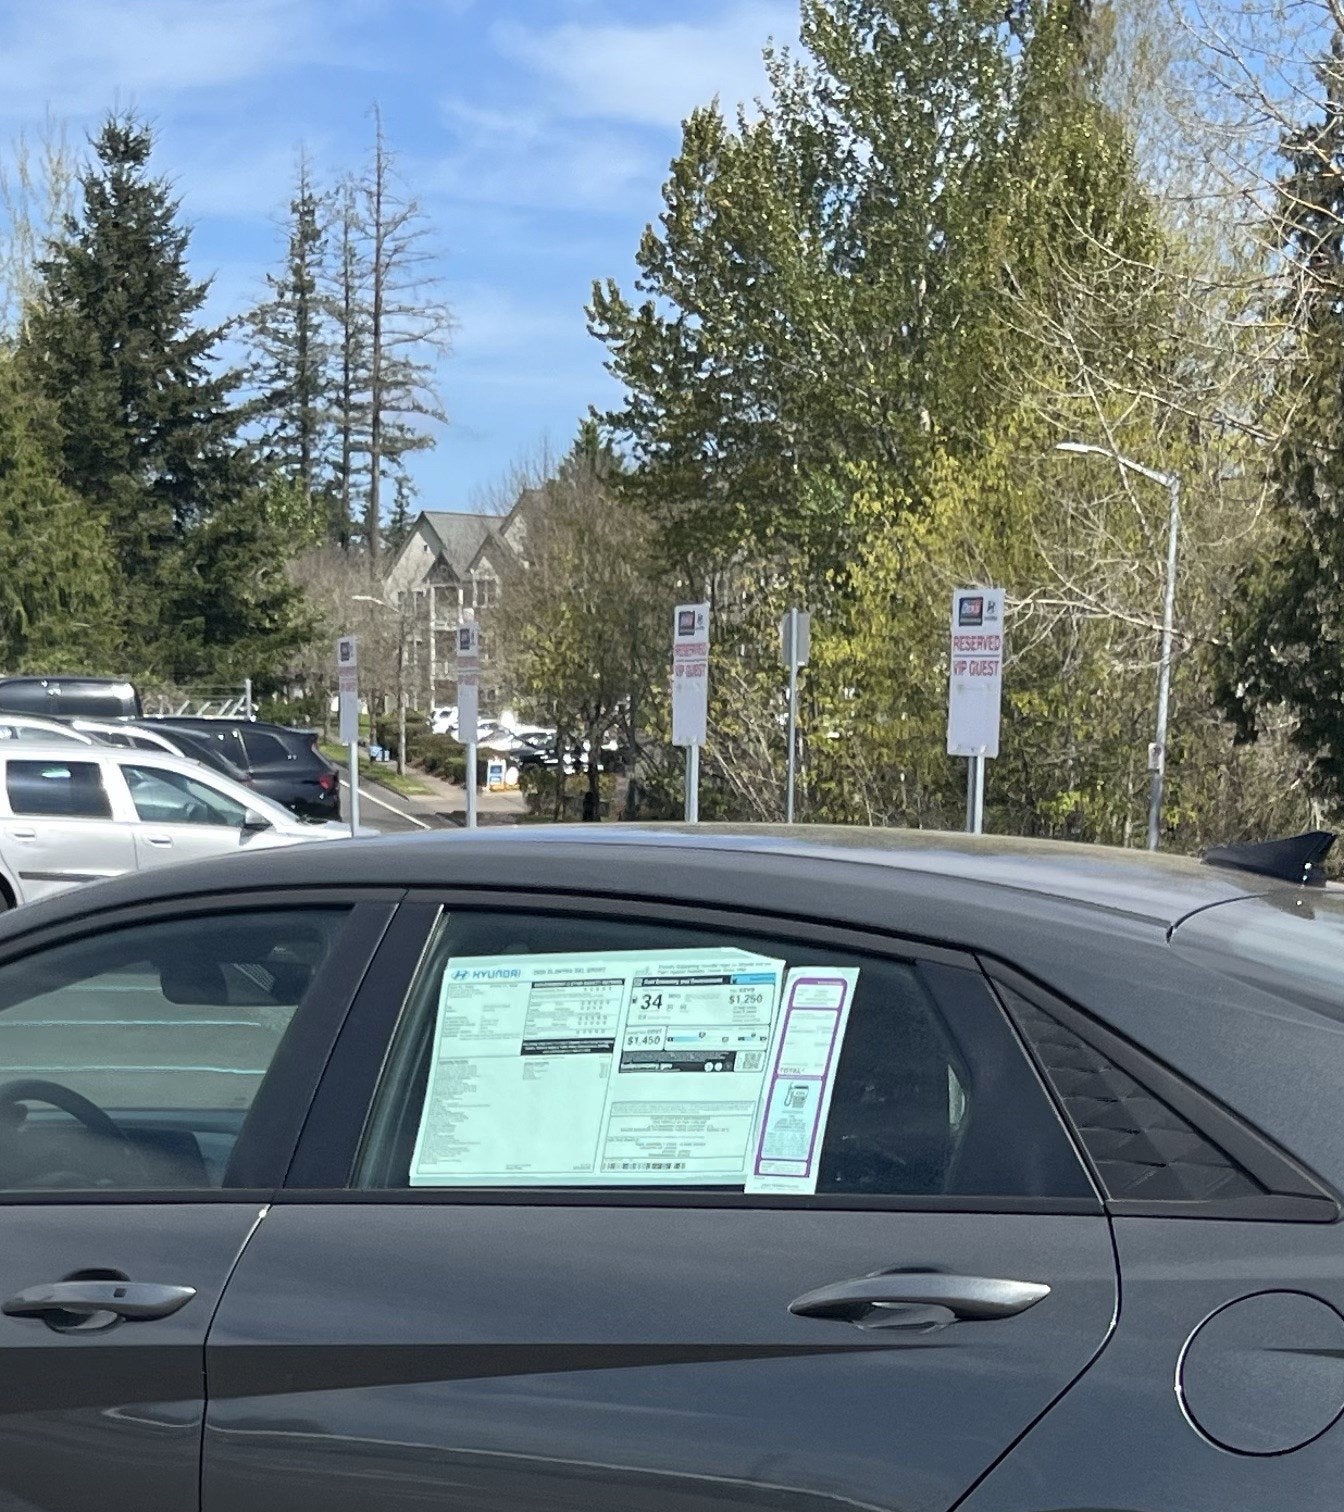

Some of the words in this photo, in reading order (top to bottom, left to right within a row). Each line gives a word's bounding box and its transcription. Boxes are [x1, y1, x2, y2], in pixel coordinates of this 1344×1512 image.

[954, 635, 1001, 651] RESERVED
[969, 661, 999, 676] GUEST
[472, 970, 521, 979] HYUNDAI
[640, 993, 663, 1010] 34
